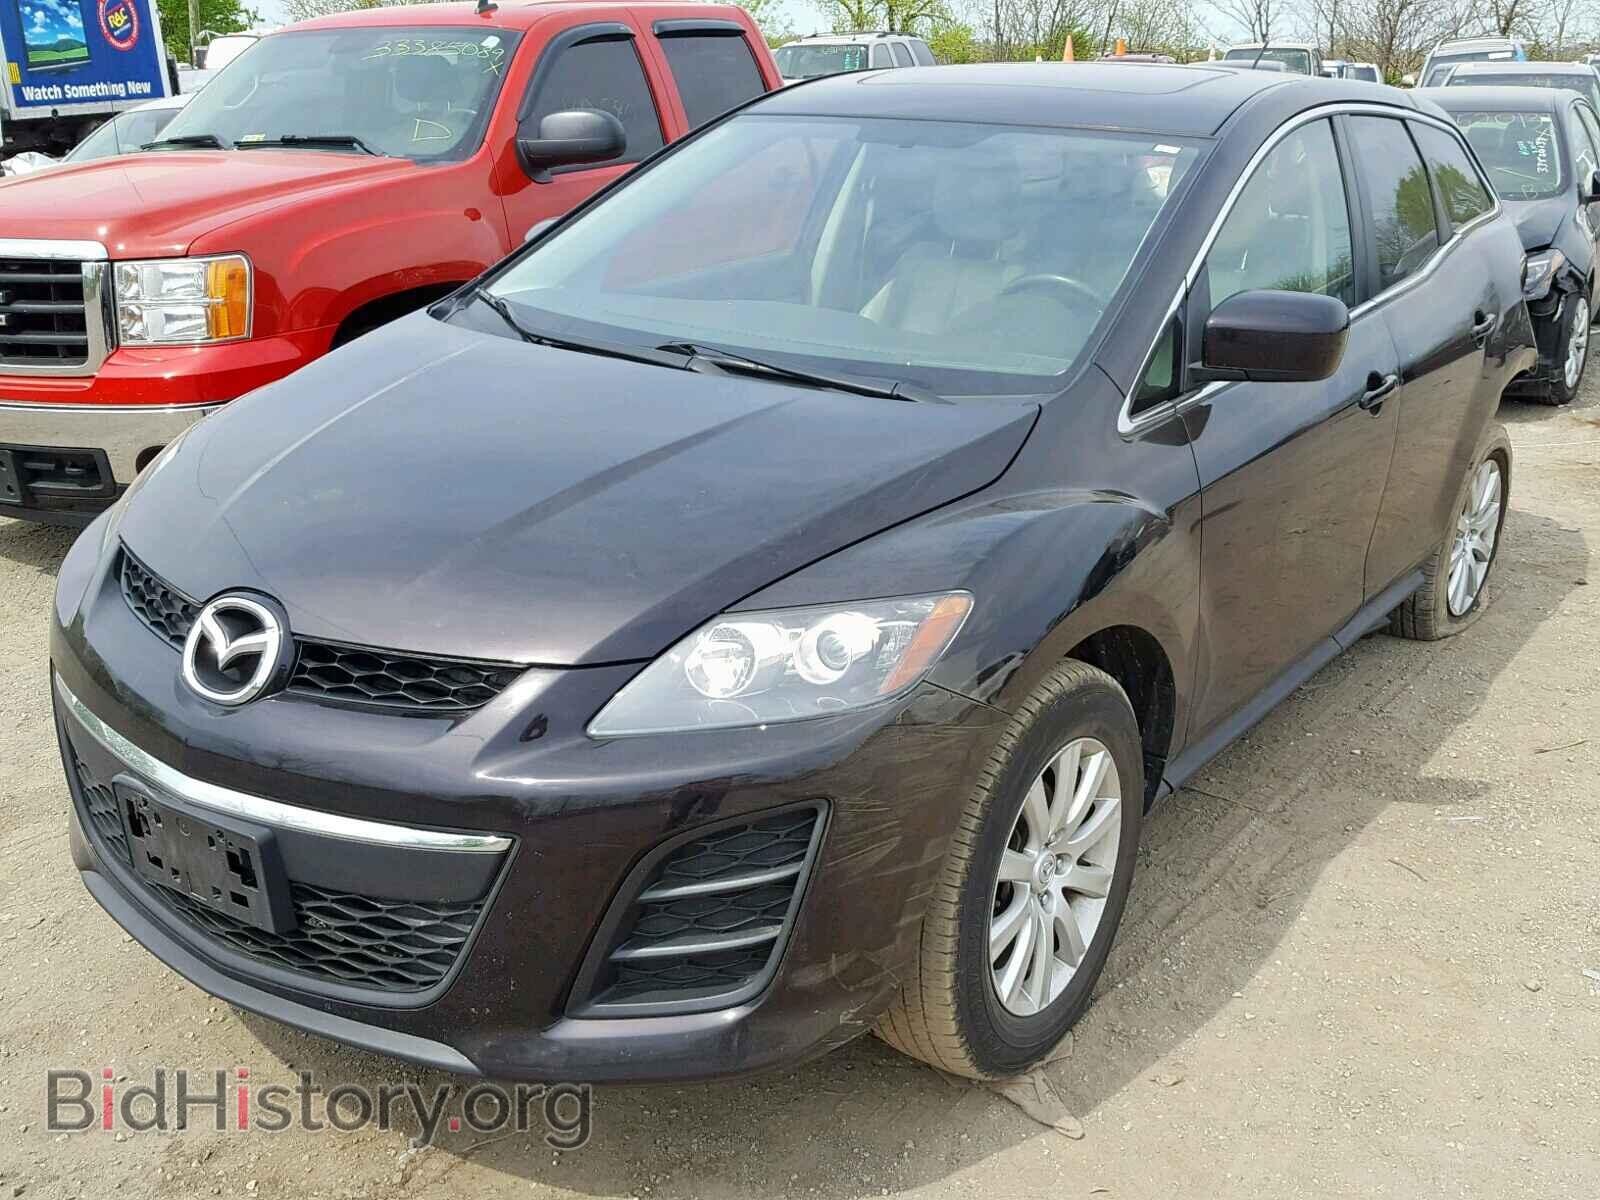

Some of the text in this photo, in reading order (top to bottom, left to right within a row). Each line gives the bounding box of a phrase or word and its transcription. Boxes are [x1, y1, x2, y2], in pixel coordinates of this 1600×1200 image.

[21, 80, 151, 101] Watch Something New
[411, 118, 452, 142] D
